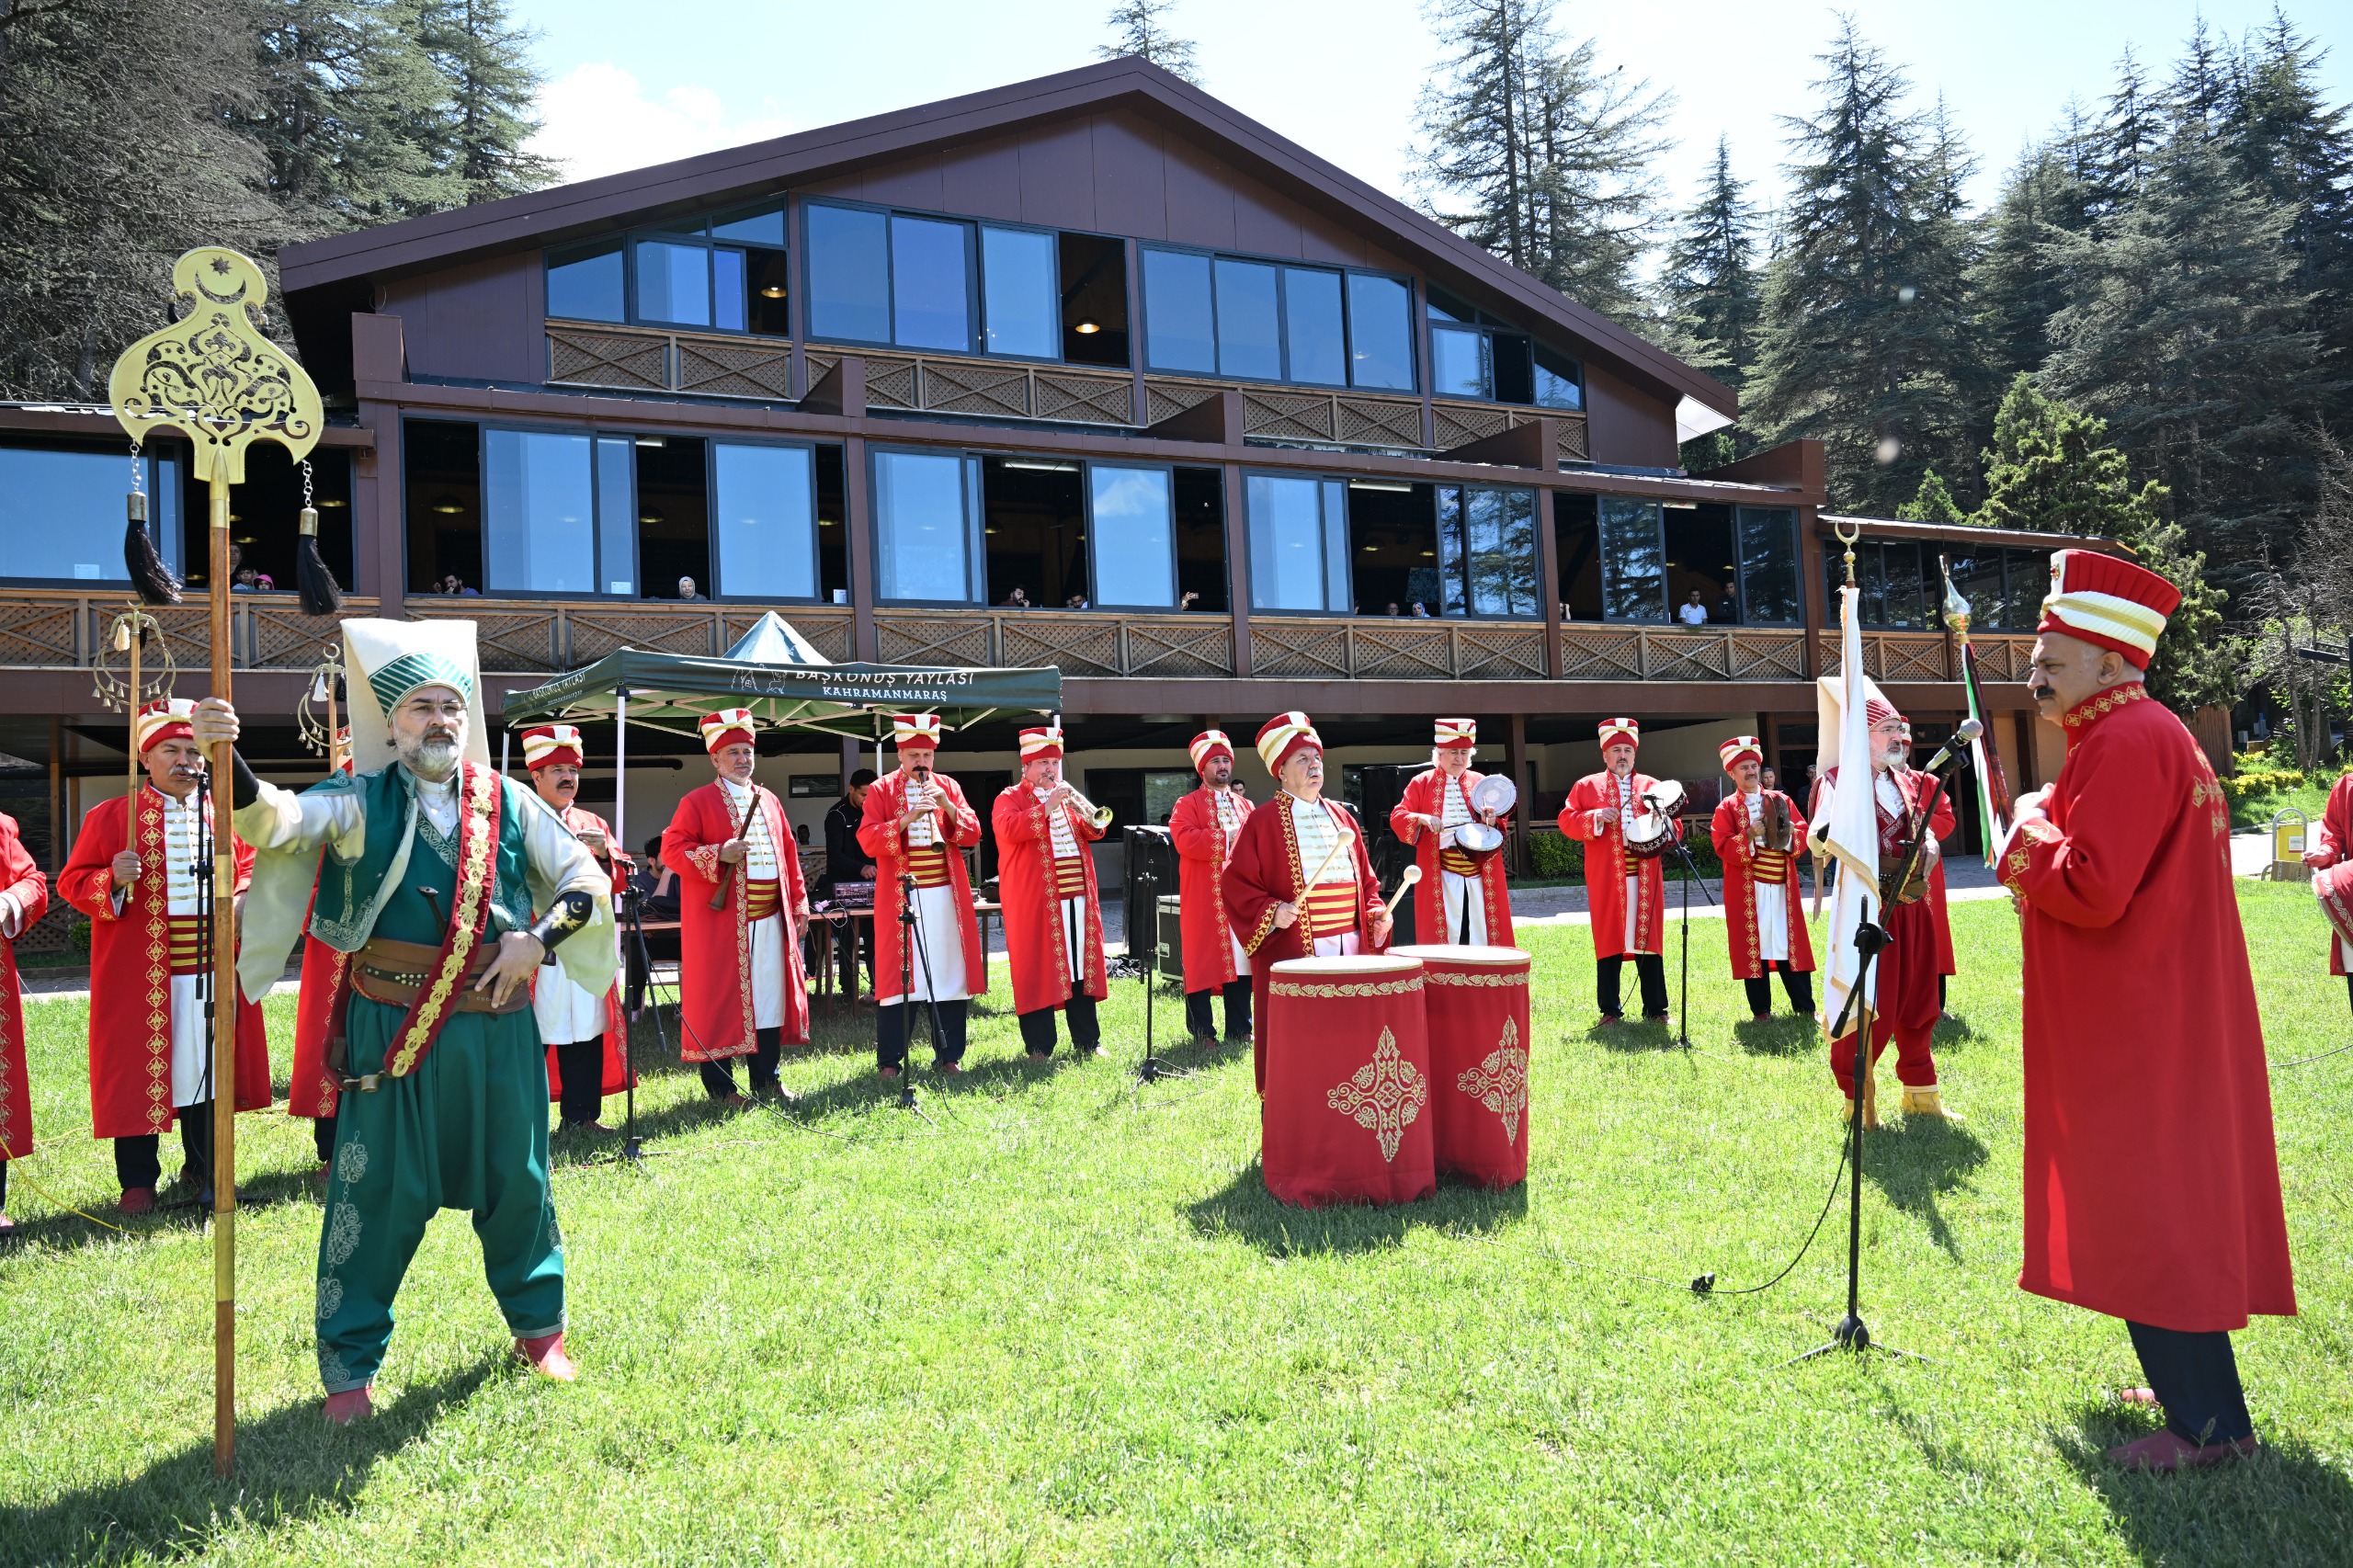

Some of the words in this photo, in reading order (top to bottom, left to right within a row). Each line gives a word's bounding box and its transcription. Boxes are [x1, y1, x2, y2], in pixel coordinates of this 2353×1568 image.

[795, 672, 896, 687] BAŞKONUŞ
[906, 672, 974, 686] YAYLASI
[823, 687, 948, 702] KAHRAMANMARAŞ
